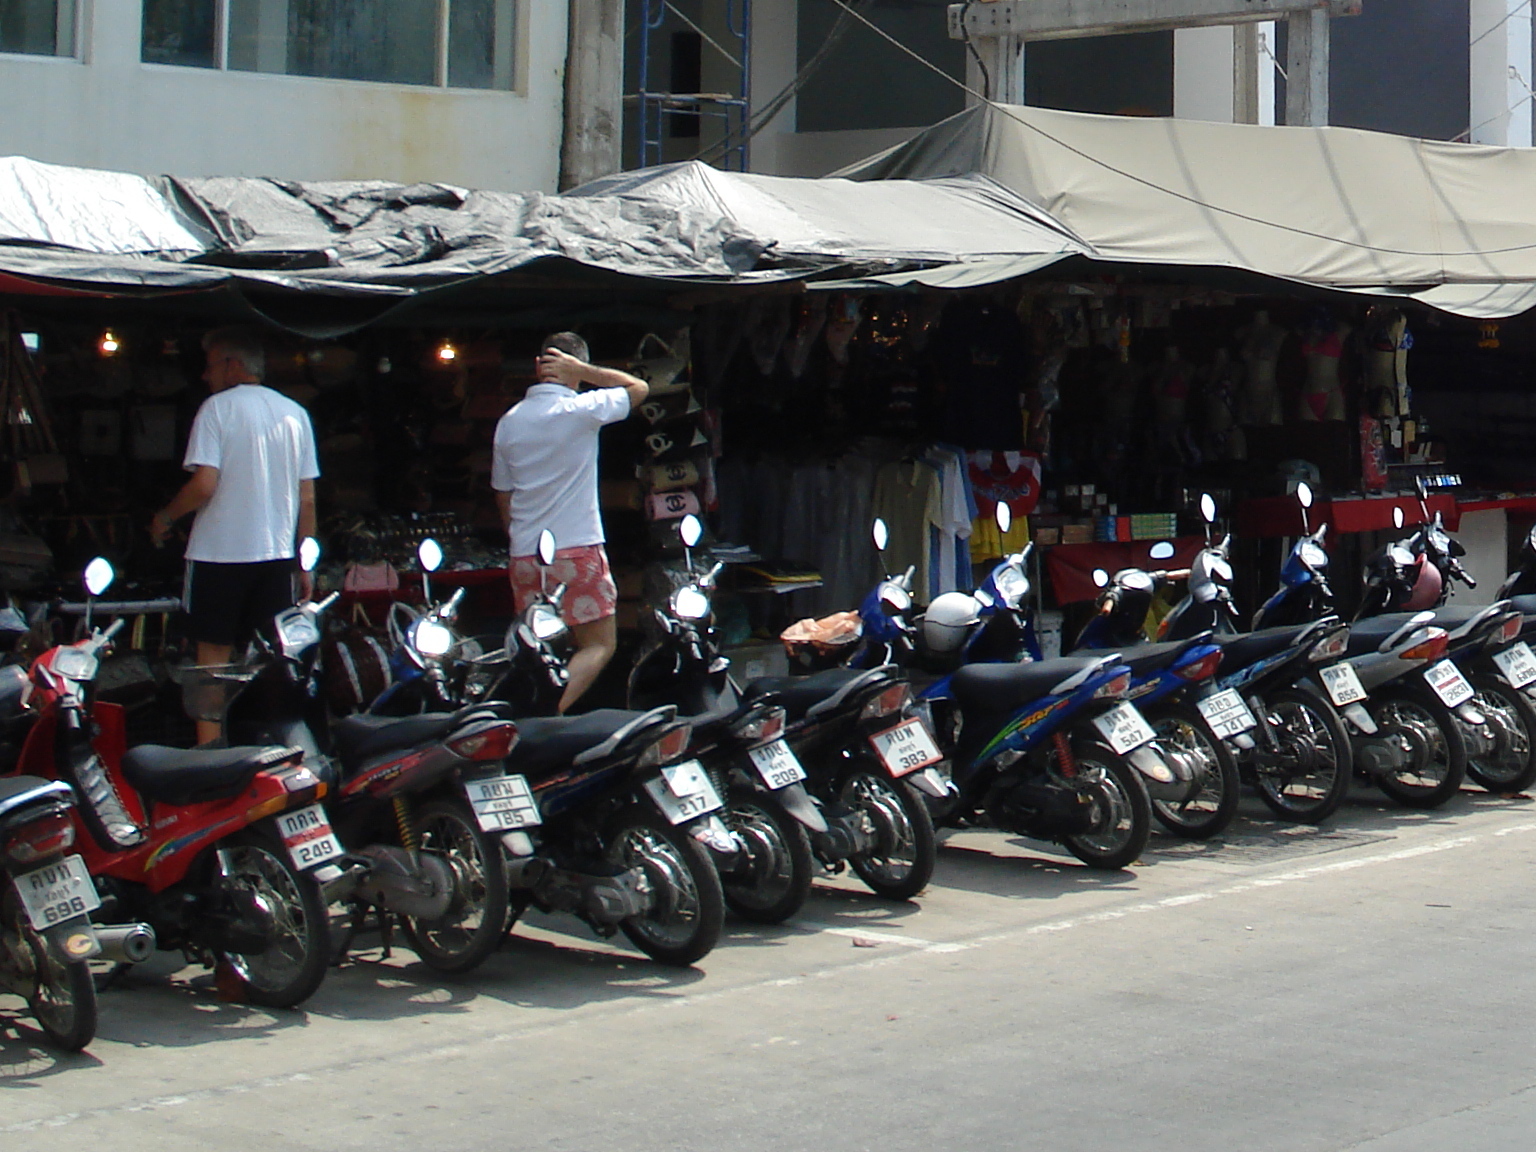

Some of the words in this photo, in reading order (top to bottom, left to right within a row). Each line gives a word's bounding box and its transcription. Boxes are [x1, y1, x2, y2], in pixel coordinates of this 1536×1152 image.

[1337, 688, 1359, 703] 855
[1222, 717, 1244, 734] 141
[1120, 731, 1144, 747] 547
[899, 750, 928, 769] 383
[771, 768, 799, 786] 209
[677, 796, 707, 817] 217
[496, 810, 525, 828] 185
[299, 839, 333, 863] 249
[44, 896, 86, 923] 696
